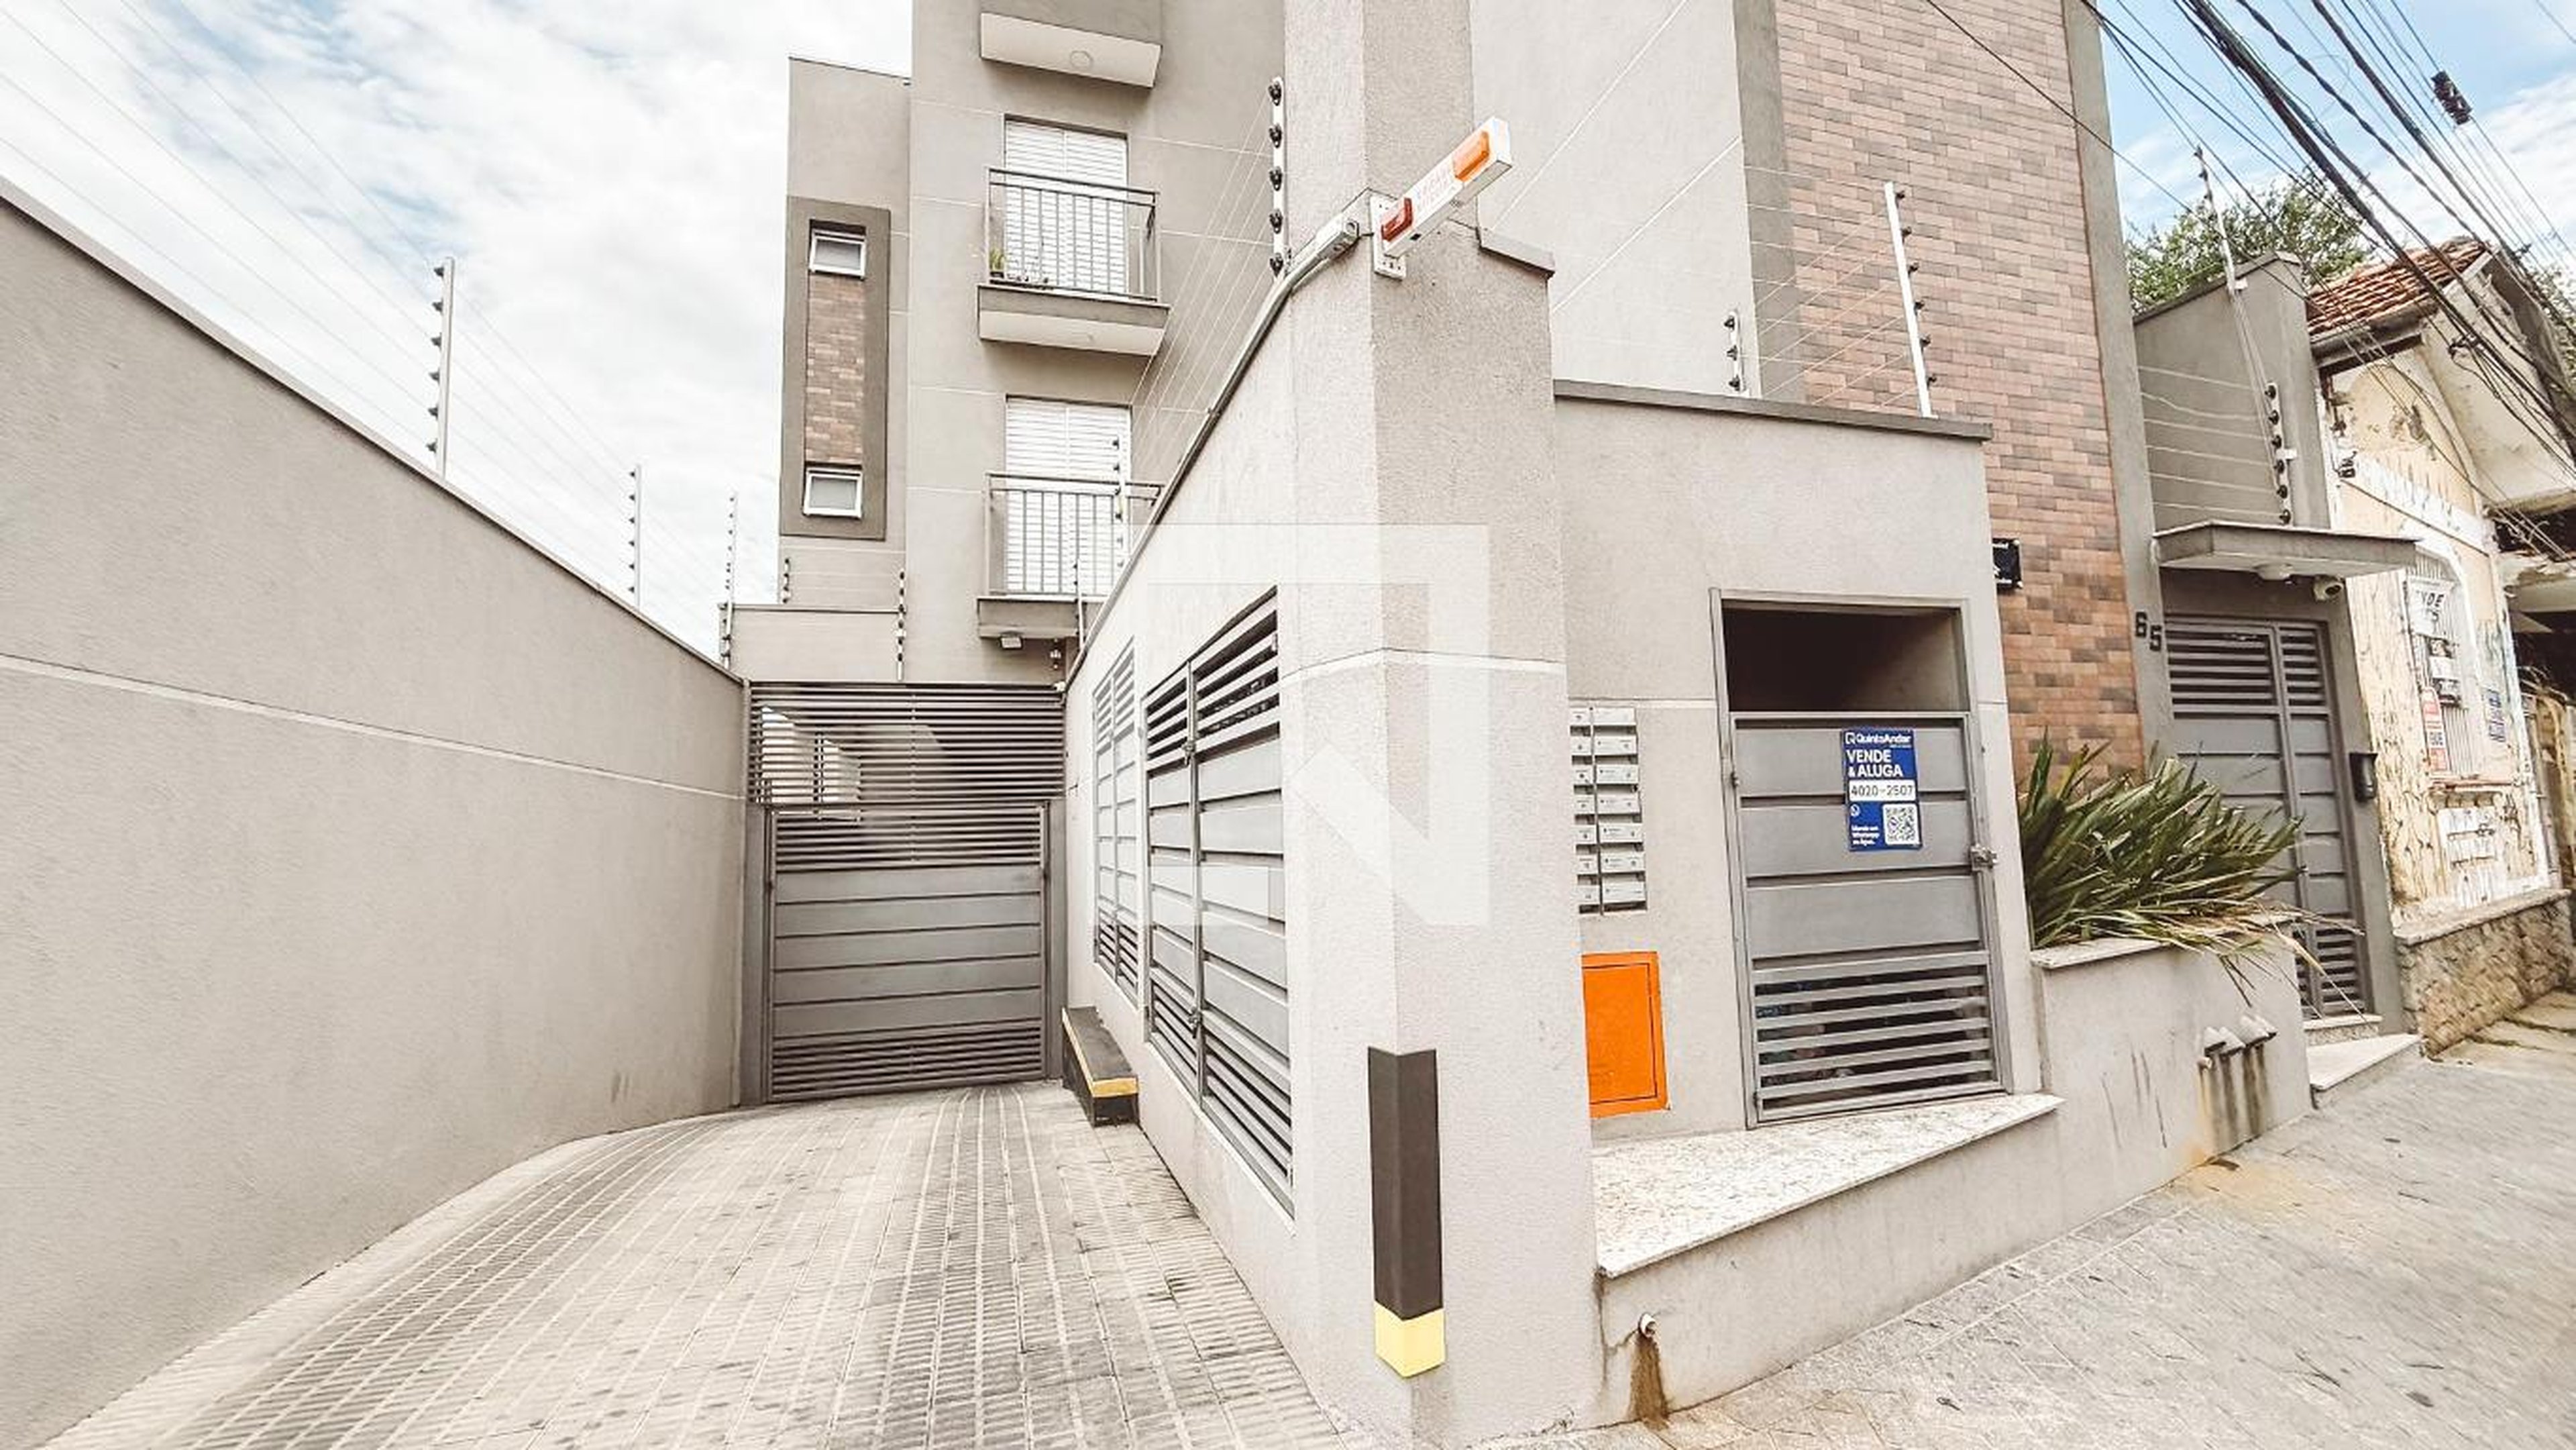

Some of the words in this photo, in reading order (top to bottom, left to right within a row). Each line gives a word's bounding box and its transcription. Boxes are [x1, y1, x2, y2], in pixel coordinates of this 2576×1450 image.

[2135, 611, 2162, 652] 65
[1846, 749, 1892, 763] VENDE
[1848, 766, 1856, 777] &
[1858, 764, 1904, 778] ALUGA
[1851, 784, 1913, 796] 4020-2507
